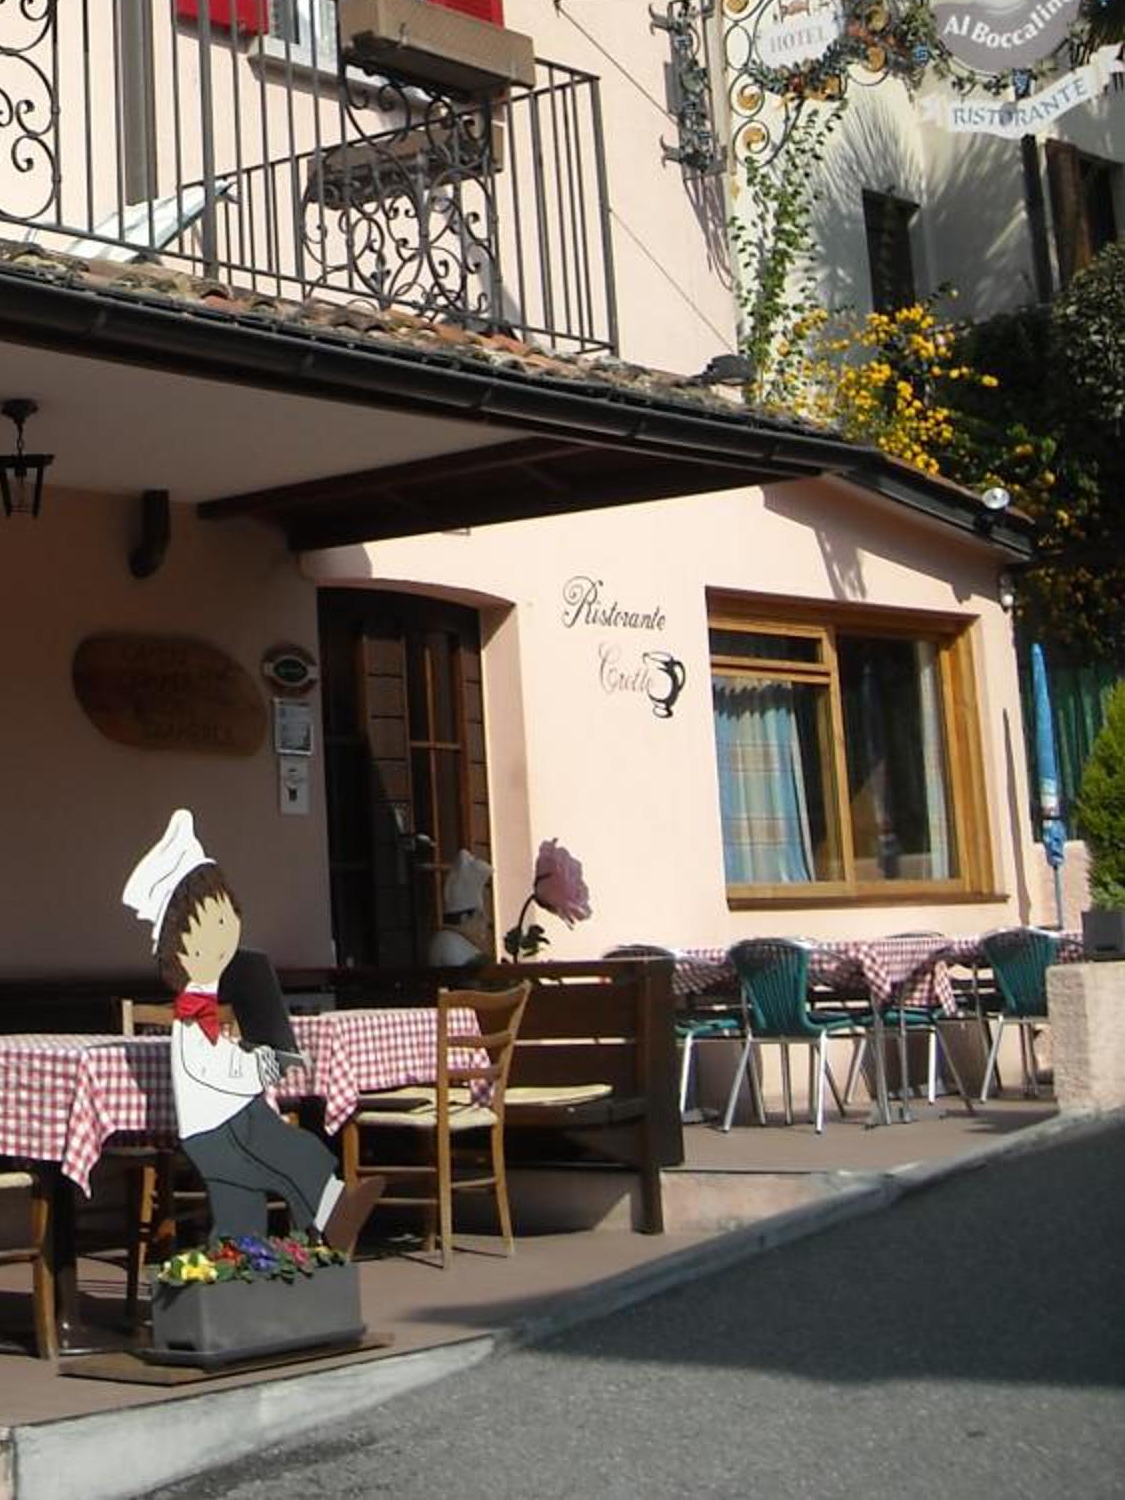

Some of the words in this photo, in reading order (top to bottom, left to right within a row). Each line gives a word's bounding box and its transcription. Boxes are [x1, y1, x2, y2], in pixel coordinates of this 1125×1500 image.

[769, 25, 829, 53] HOTEL
[944, 14, 970, 37] Al
[953, 75, 1088, 126] RISTORANTE
[562, 575, 667, 631] Ristorante
